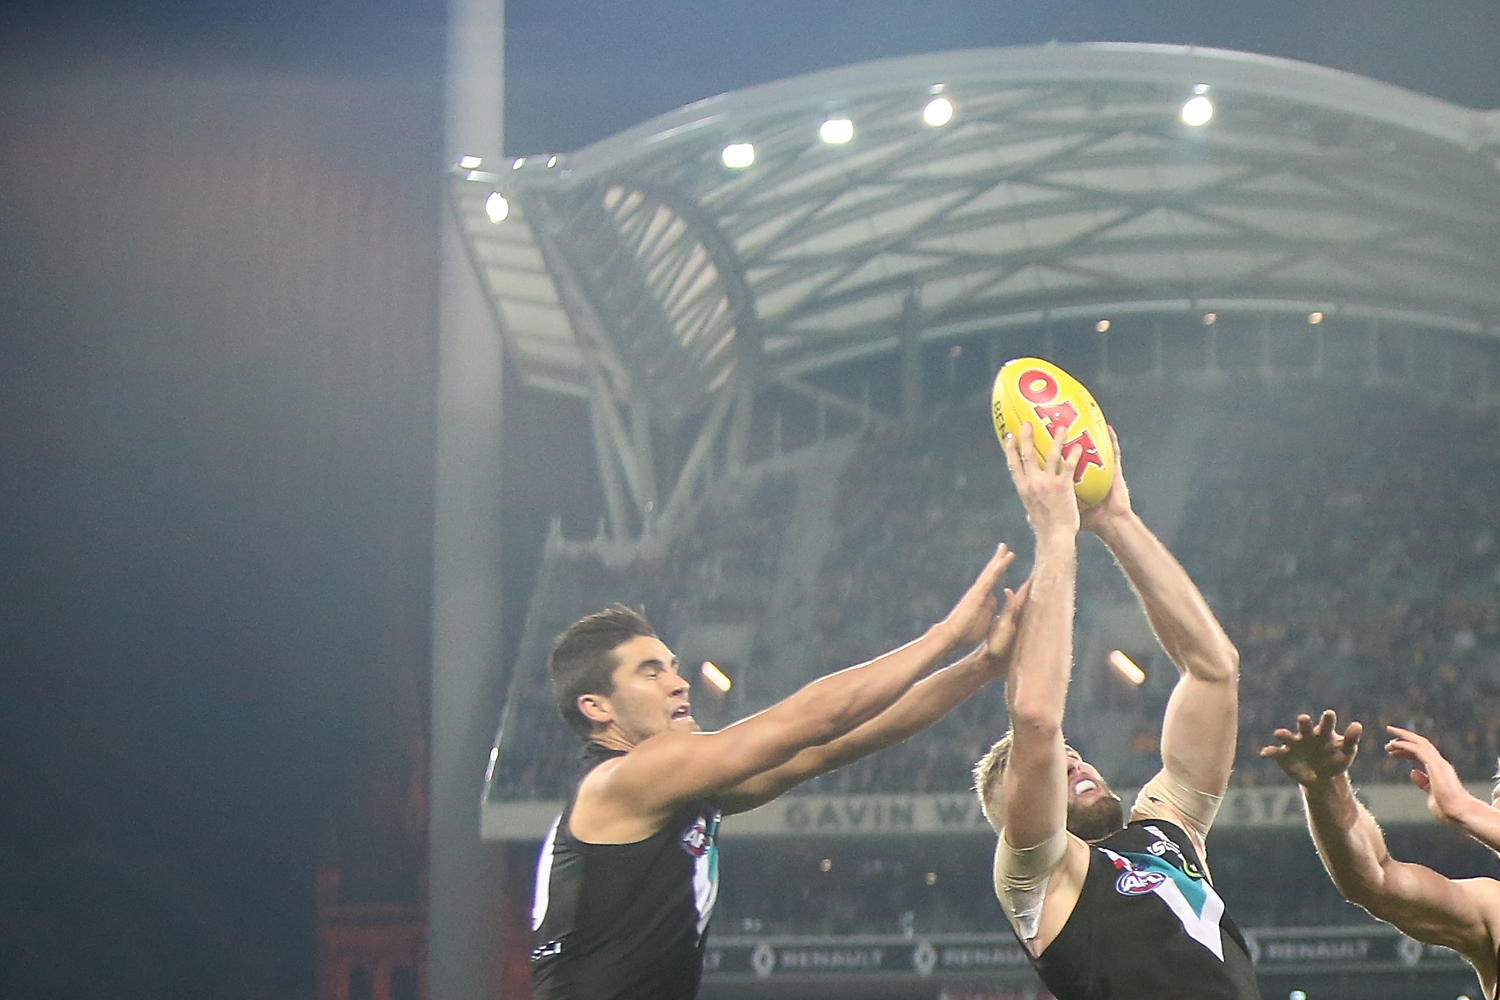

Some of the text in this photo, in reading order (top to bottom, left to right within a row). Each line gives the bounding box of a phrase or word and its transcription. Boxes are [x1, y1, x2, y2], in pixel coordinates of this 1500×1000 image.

[1018, 369, 1105, 484] OAK
[785, 801, 914, 829] GAVIN
[1121, 870, 1166, 893] AFL
